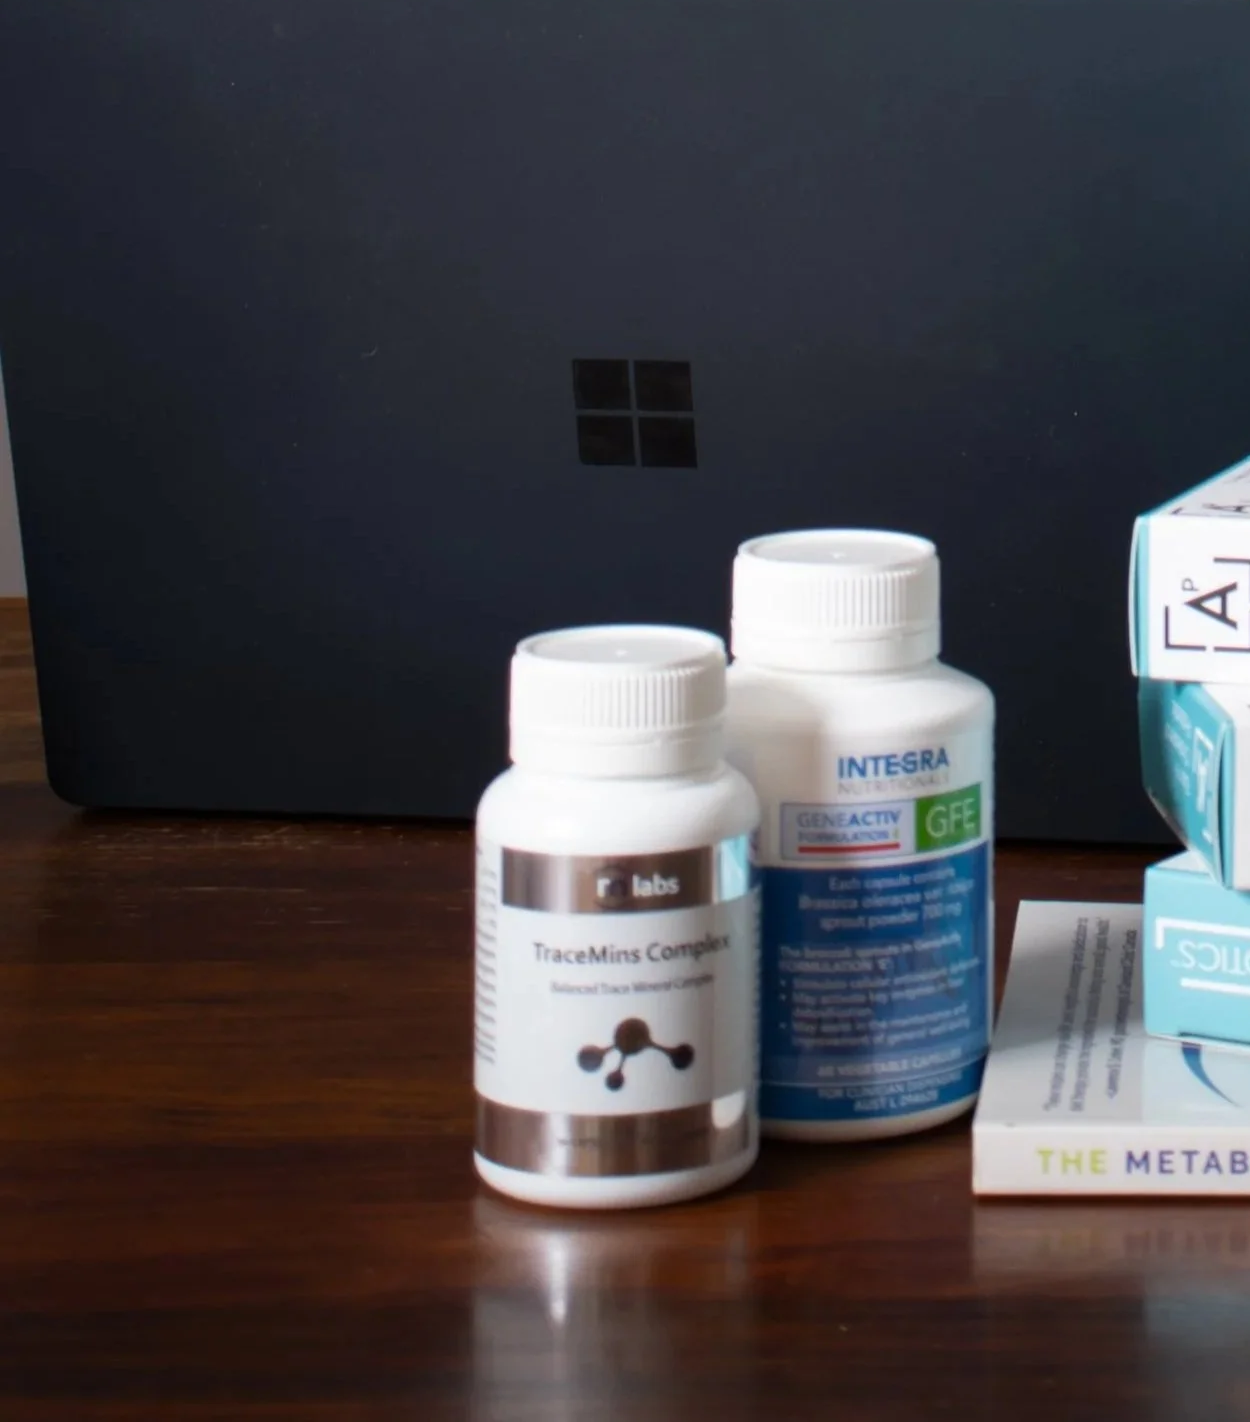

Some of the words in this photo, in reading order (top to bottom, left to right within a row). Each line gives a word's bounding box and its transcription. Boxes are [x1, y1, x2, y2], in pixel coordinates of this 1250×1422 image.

[838, 746, 949, 779] INTEGRA
[925, 798, 976, 838] GFE
[632, 872, 679, 898] labs
[533, 942, 640, 965] TraceMins
[646, 932, 730, 963] Complex
[1037, 1148, 1107, 1175] THE
